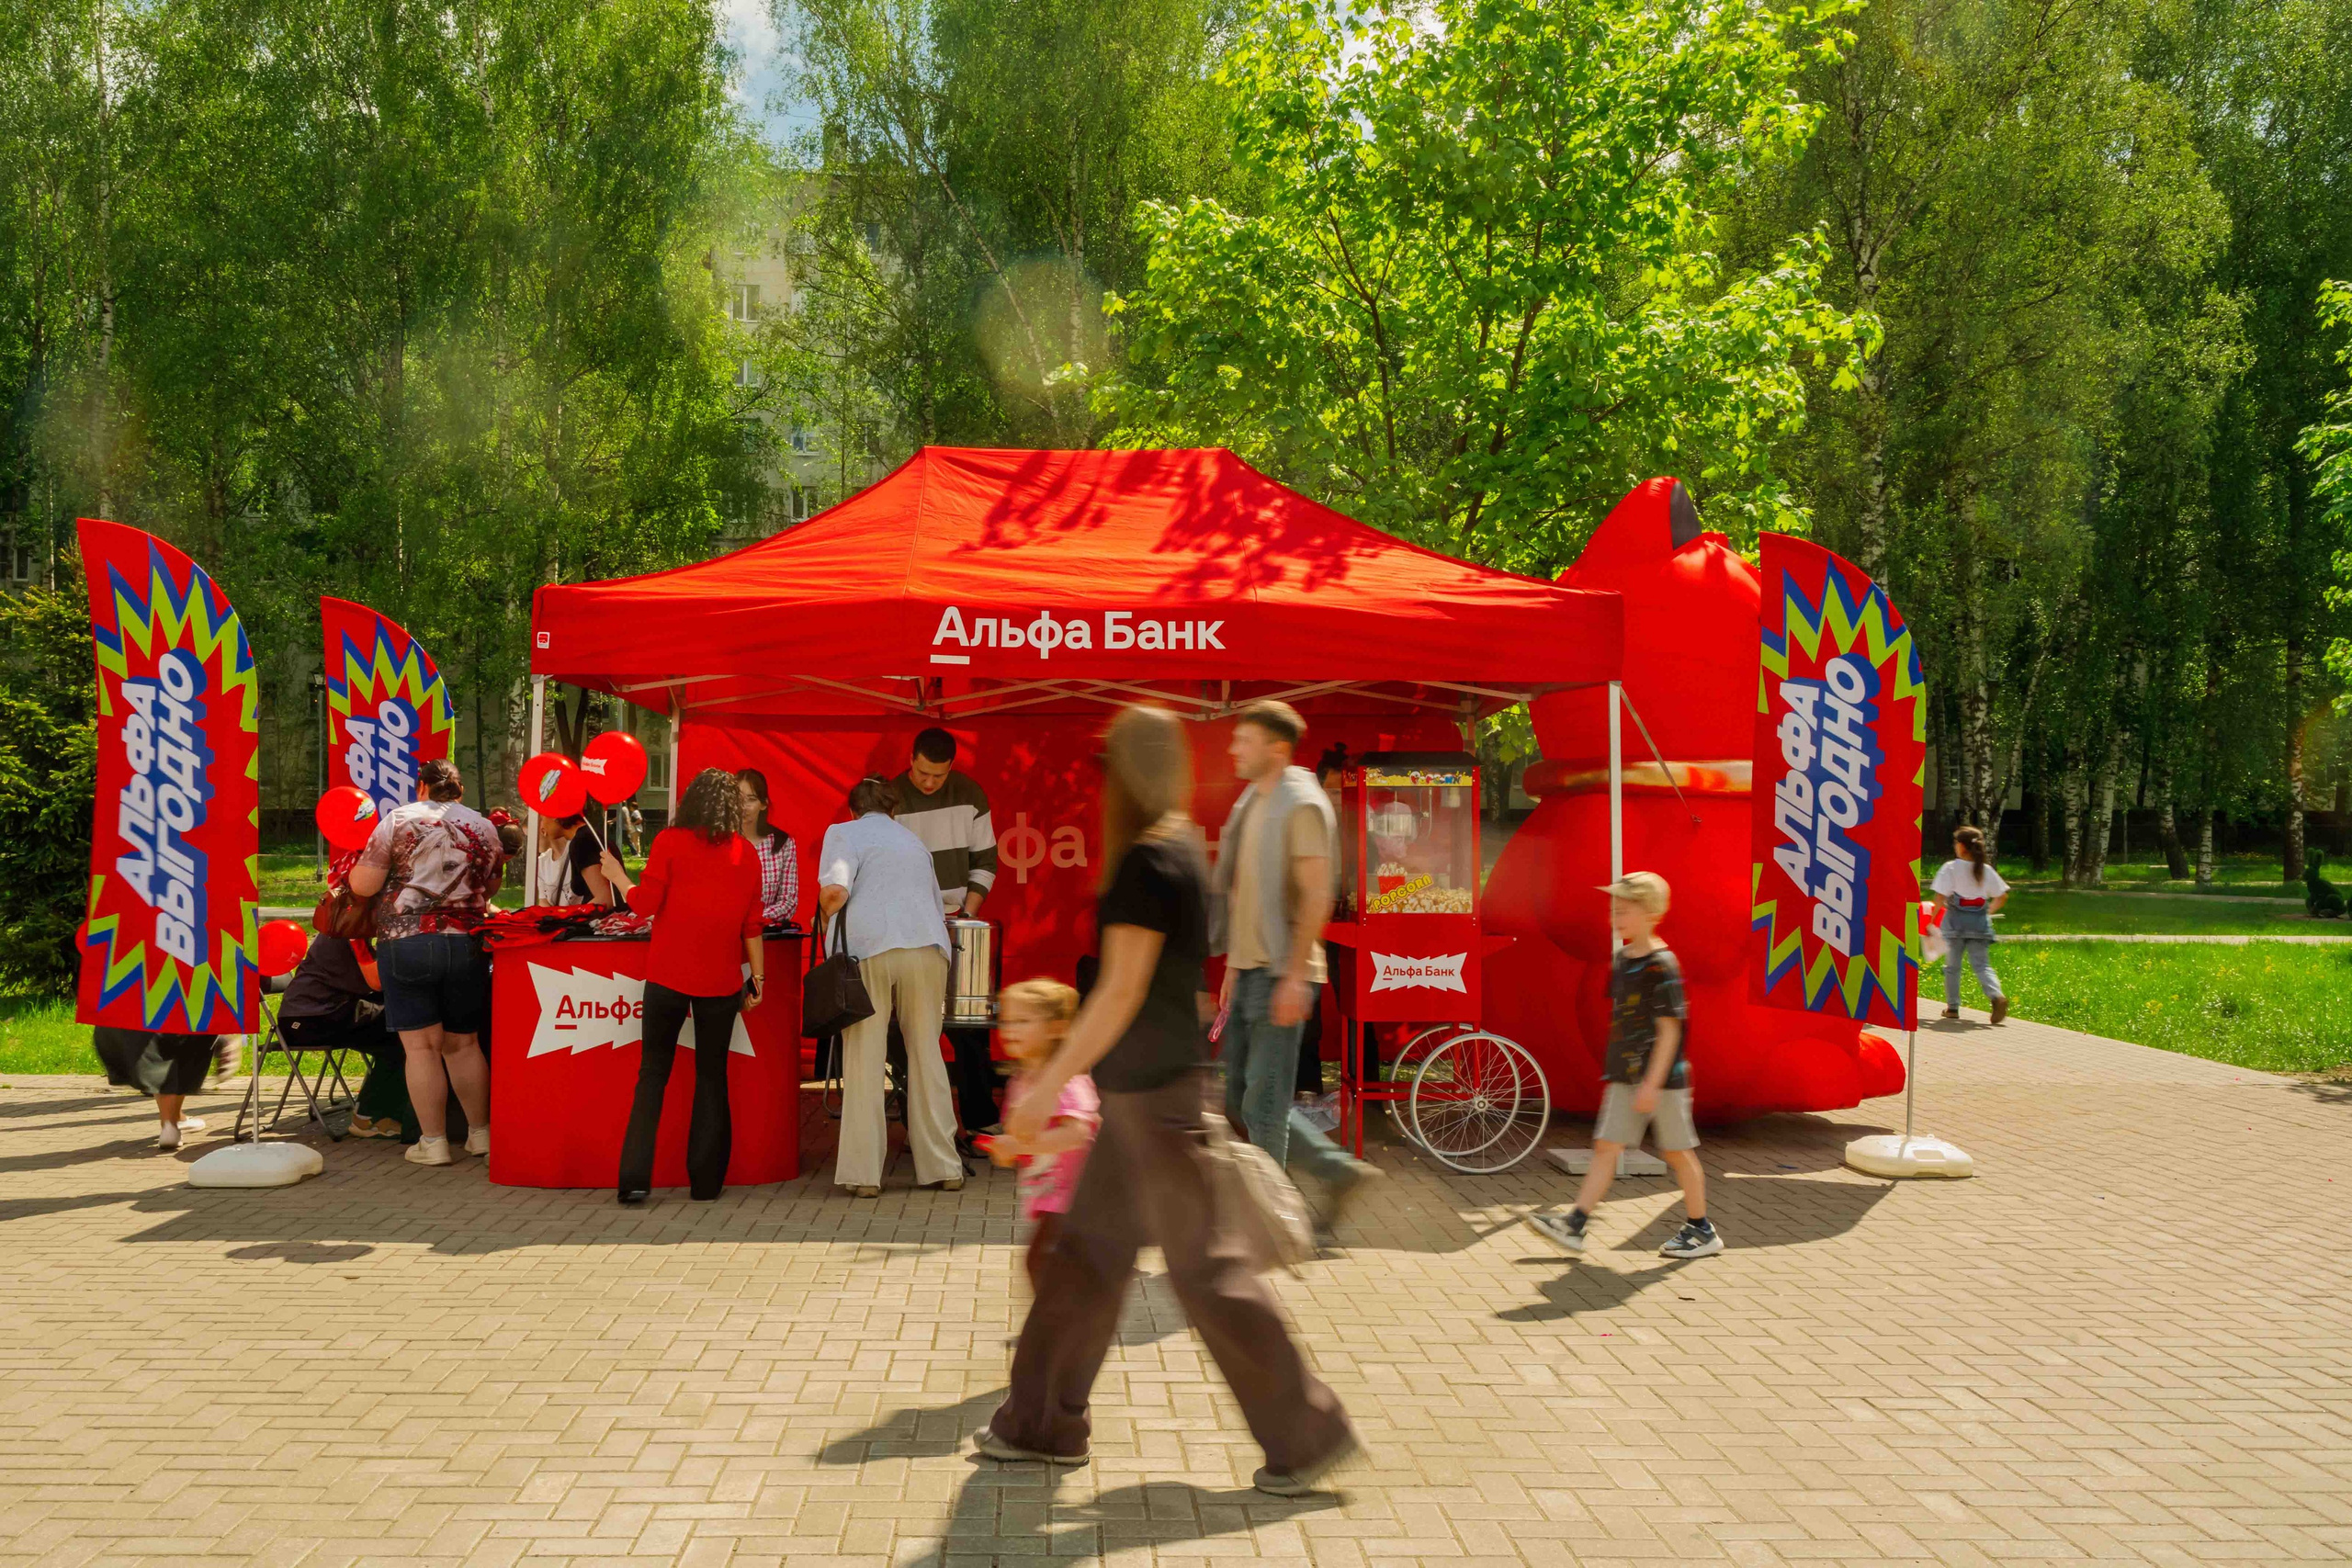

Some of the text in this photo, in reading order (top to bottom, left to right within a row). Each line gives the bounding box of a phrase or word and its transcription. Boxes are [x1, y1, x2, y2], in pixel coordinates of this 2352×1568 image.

[932, 605, 1227, 660] Альфа Банк
[117, 682, 156, 907] АЛЬФА
[155, 653, 202, 967] ВЫГОДНО
[1373, 874, 1433, 910] POPCORN
[1773, 681, 1820, 897] АЛЬФА
[1813, 656, 1871, 957] ВЫГОДНО
[1383, 964, 1454, 979] Альфа Банк
